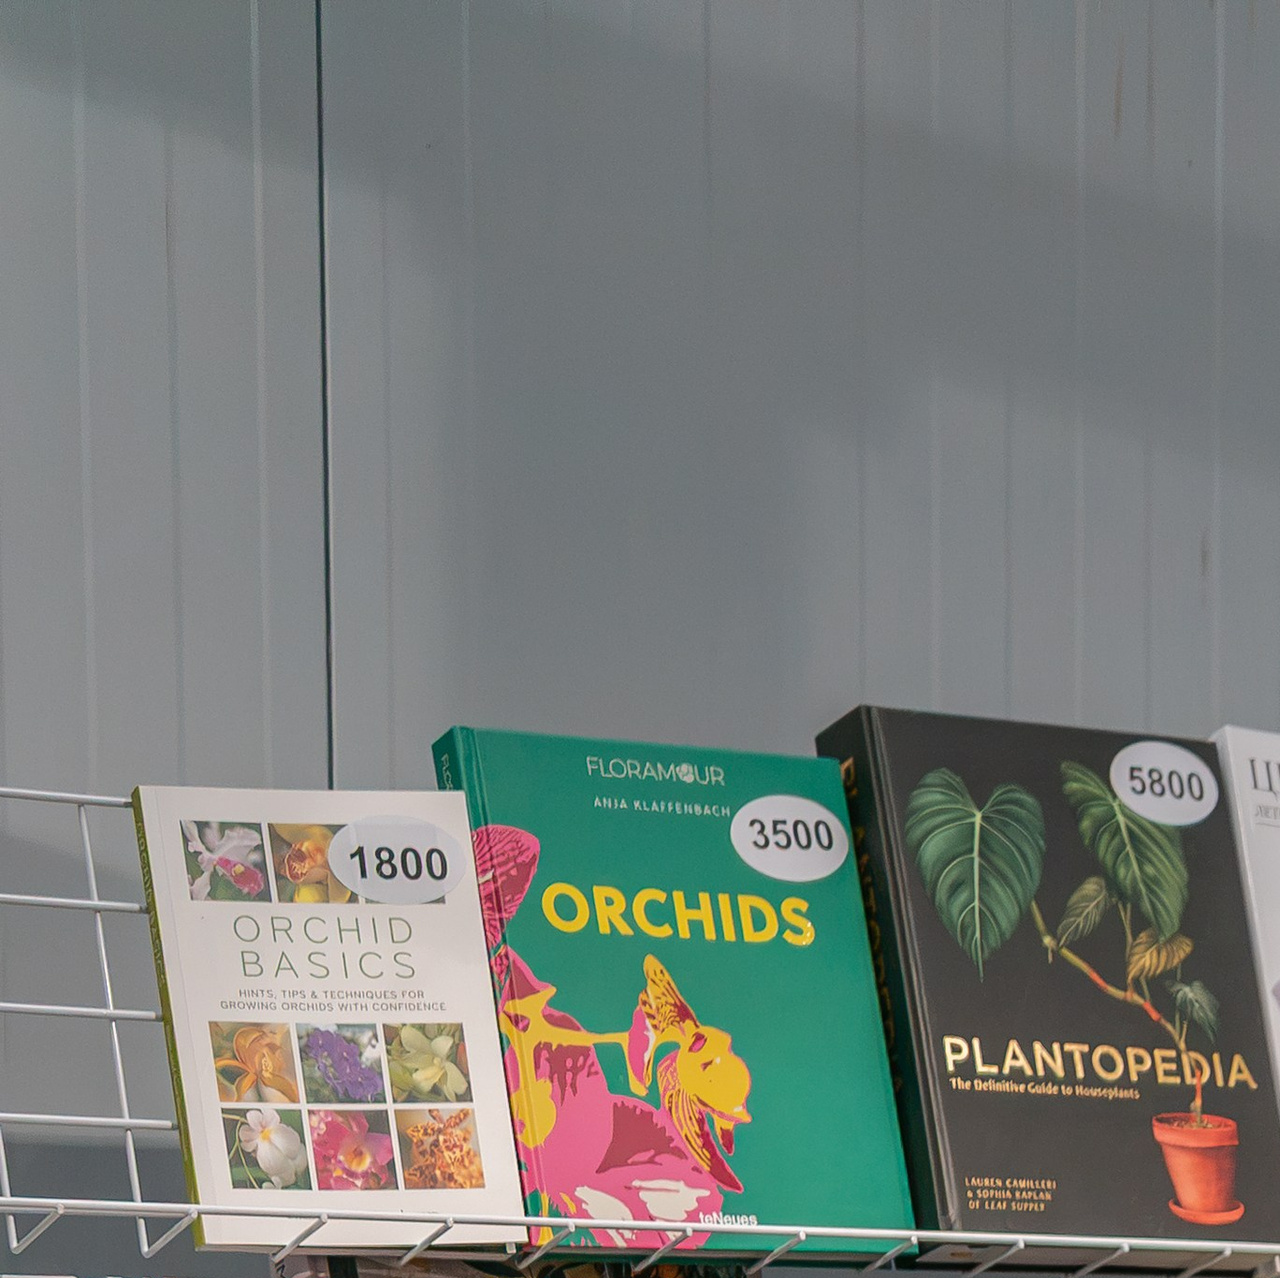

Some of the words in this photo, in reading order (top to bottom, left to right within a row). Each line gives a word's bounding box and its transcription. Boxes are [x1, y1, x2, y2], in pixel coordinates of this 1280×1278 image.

[1128, 766, 1203, 802] 5800
[749, 819, 834, 851] 3500
[349, 845, 448, 881] 1800
[541, 882, 816, 946] ORCHIDS
[233, 915, 413, 945] ORCHID
[241, 951, 417, 980] BASICS
[281, 1001, 335, 1013] ORCHIDS
[371, 1002, 448, 1013] CONFIDENCE
[322, 990, 398, 1001] TECHNIQUES
[943, 1035, 1258, 1090] PLANTOPEDIA
[974, 1079, 1026, 1094] Definitive
[1027, 1081, 1059, 1095] Guide
[1075, 1085, 1141, 1101] Houseplants
[699, 1210, 758, 1227] teNeues
